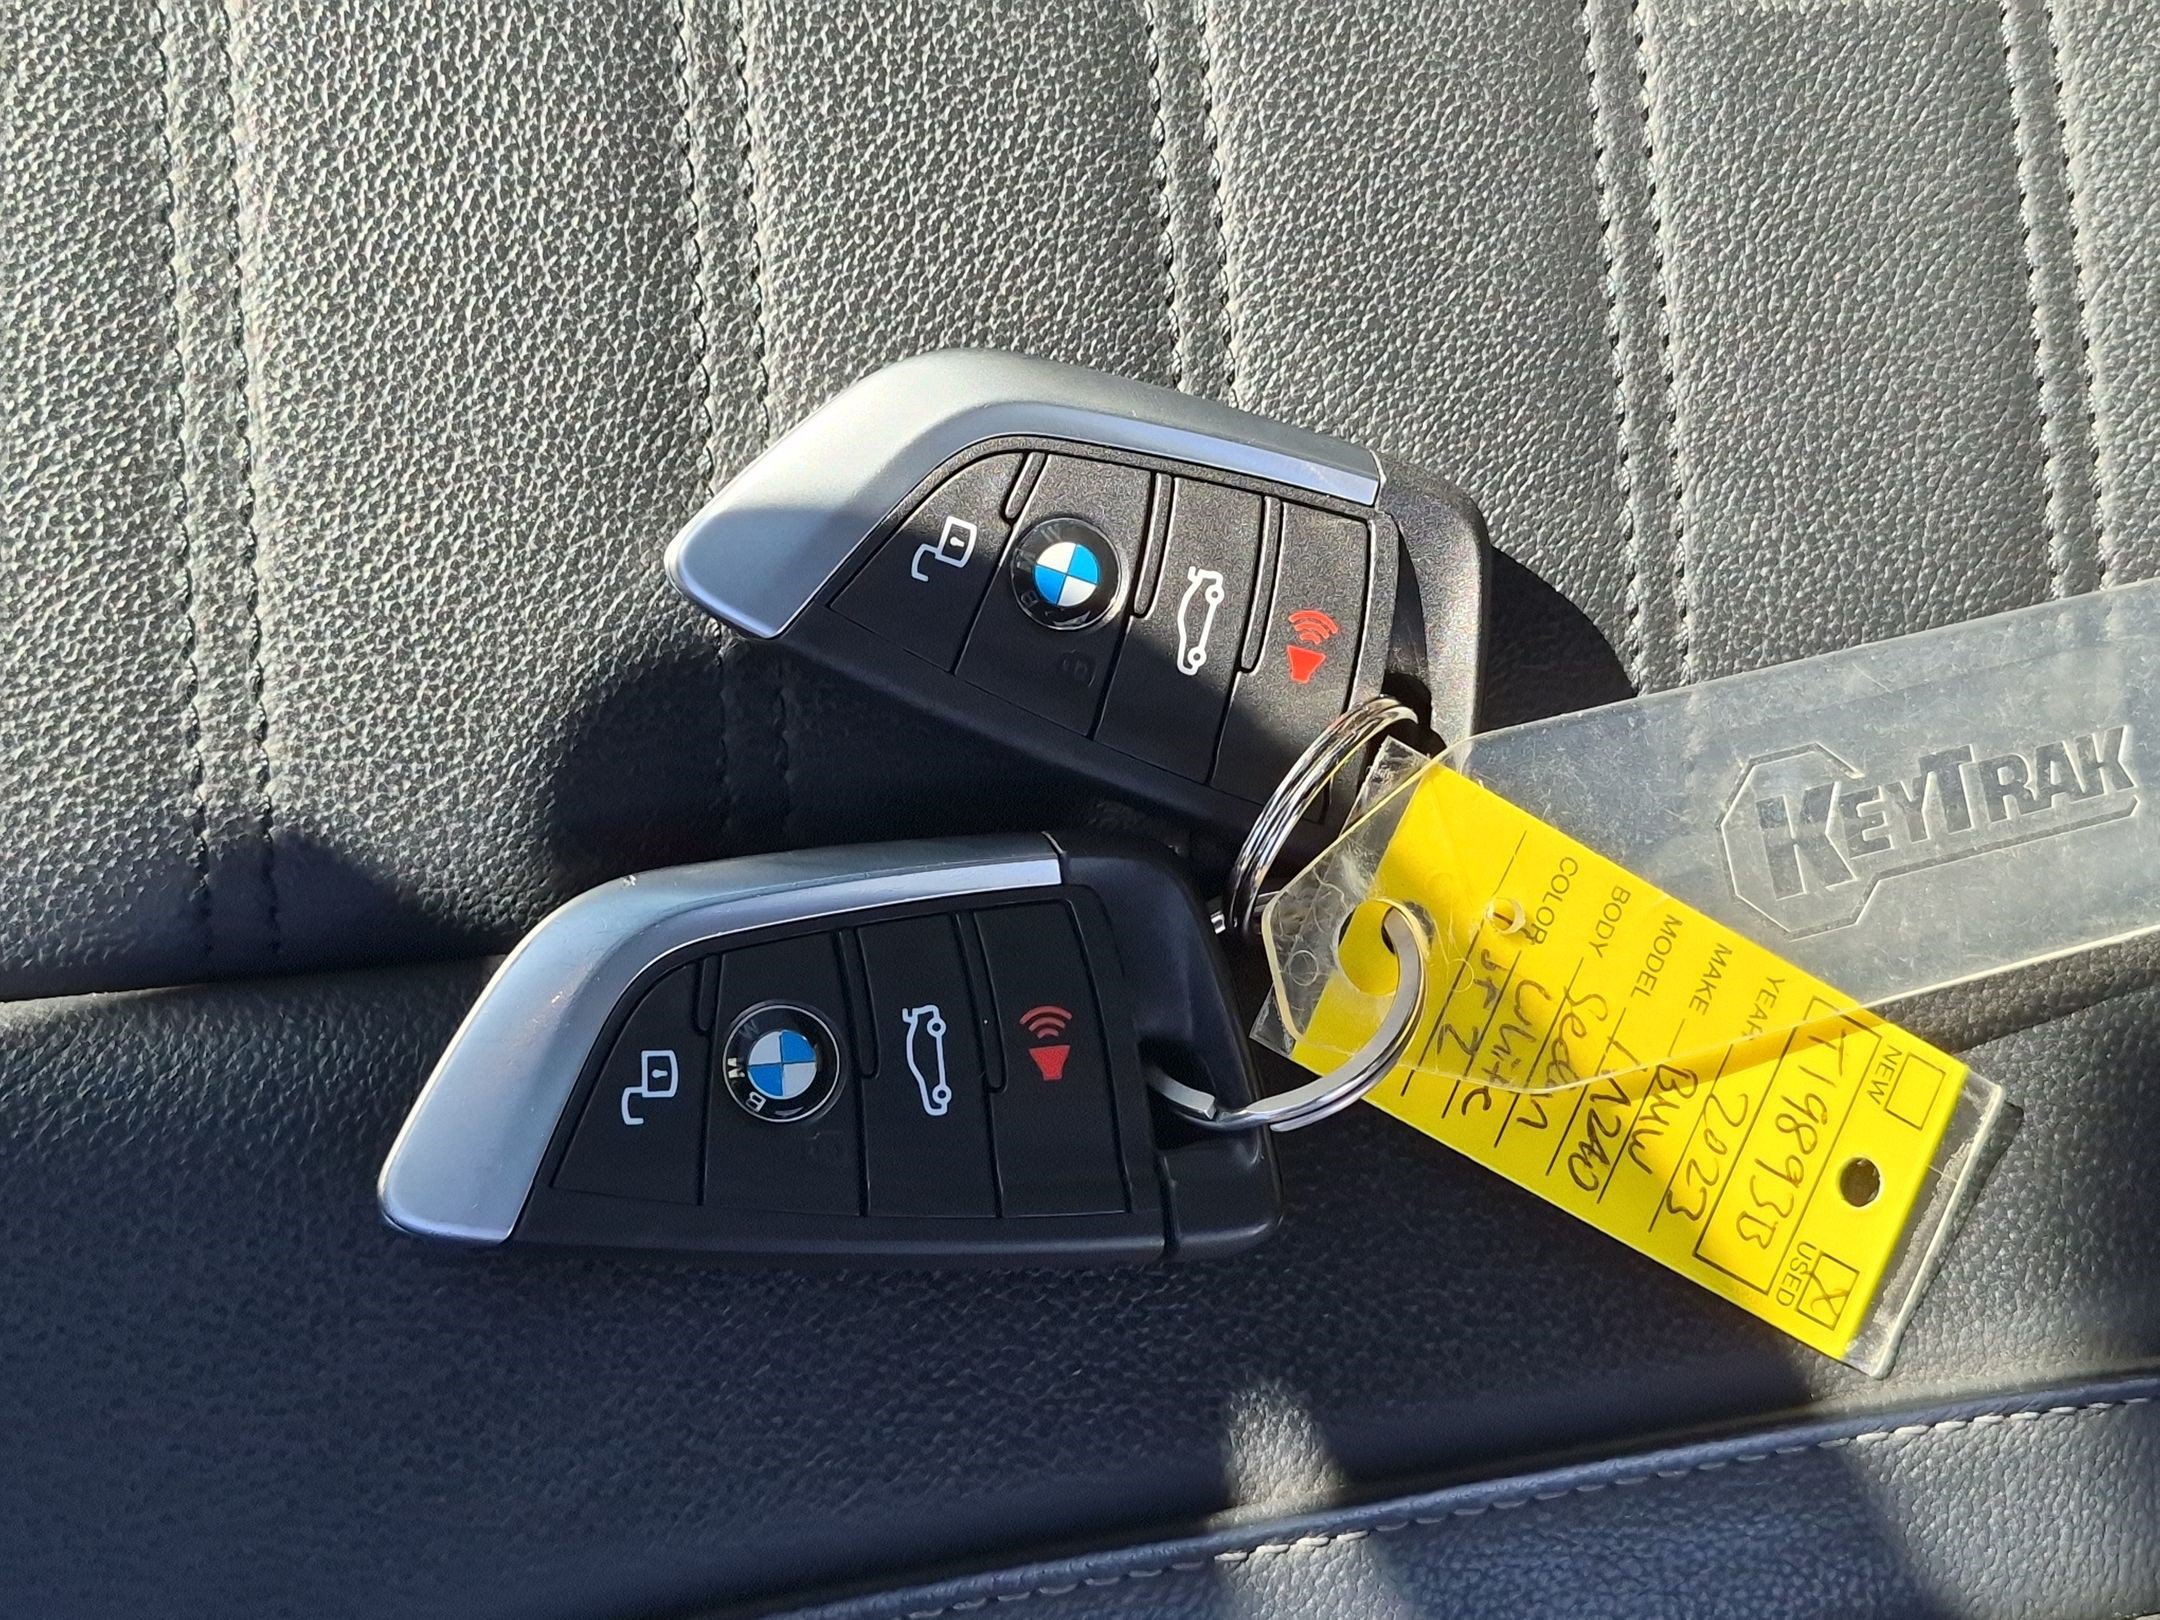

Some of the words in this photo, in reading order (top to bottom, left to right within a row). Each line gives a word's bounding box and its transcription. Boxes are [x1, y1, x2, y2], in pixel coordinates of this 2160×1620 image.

[1525, 857, 1577, 945] COLOR
[1589, 884, 1631, 959] BODY
[1629, 913, 1683, 997] MODEL
[1687, 942, 1732, 1015] MAKE
[1864, 1043, 1903, 1105] NEW
[1628, 1064, 1697, 1175] BMW
[1667, 1093, 1745, 1221] 2023
[1736, 1030, 1845, 1250] T19893B
[1772, 1239, 1816, 1309] USED
